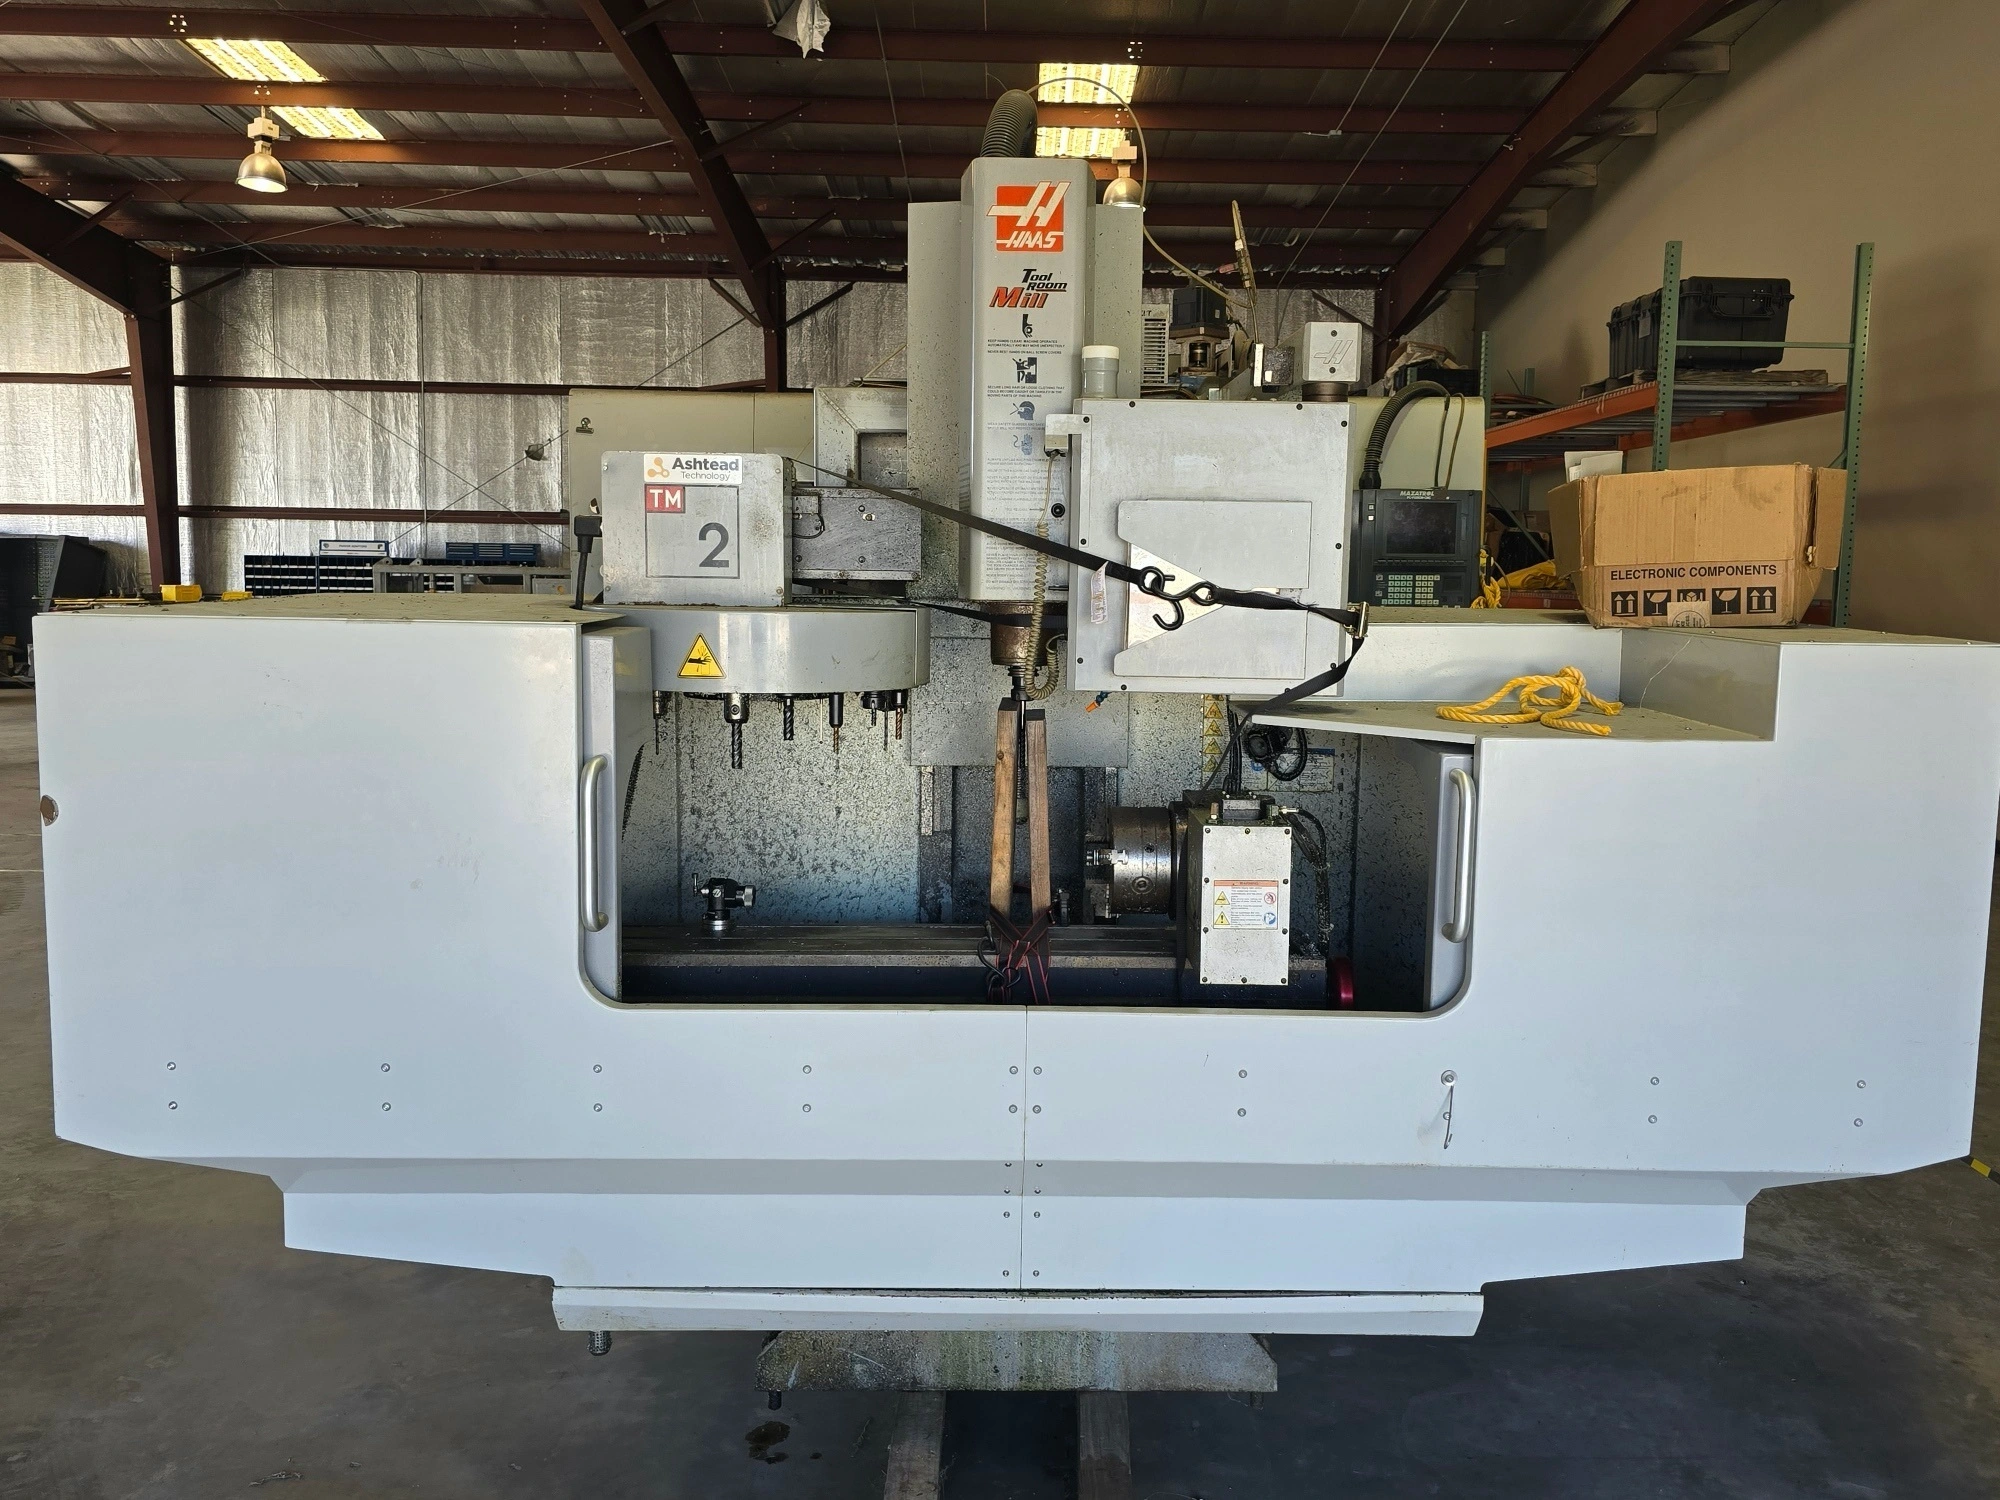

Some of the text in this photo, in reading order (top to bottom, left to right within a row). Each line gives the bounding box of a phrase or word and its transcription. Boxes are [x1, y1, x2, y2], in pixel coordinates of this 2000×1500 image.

[996, 231, 1064, 248] HAAS
[1022, 268, 1053, 283] Tool
[989, 287, 1049, 308] Mill
[672, 457, 739, 471] Ashtead
[681, 471, 730, 481] Technology
[650, 489, 681, 509] TM
[698, 522, 730, 568] 2
[1610, 564, 1777, 580] ELECTRONIC COMPONENTS
